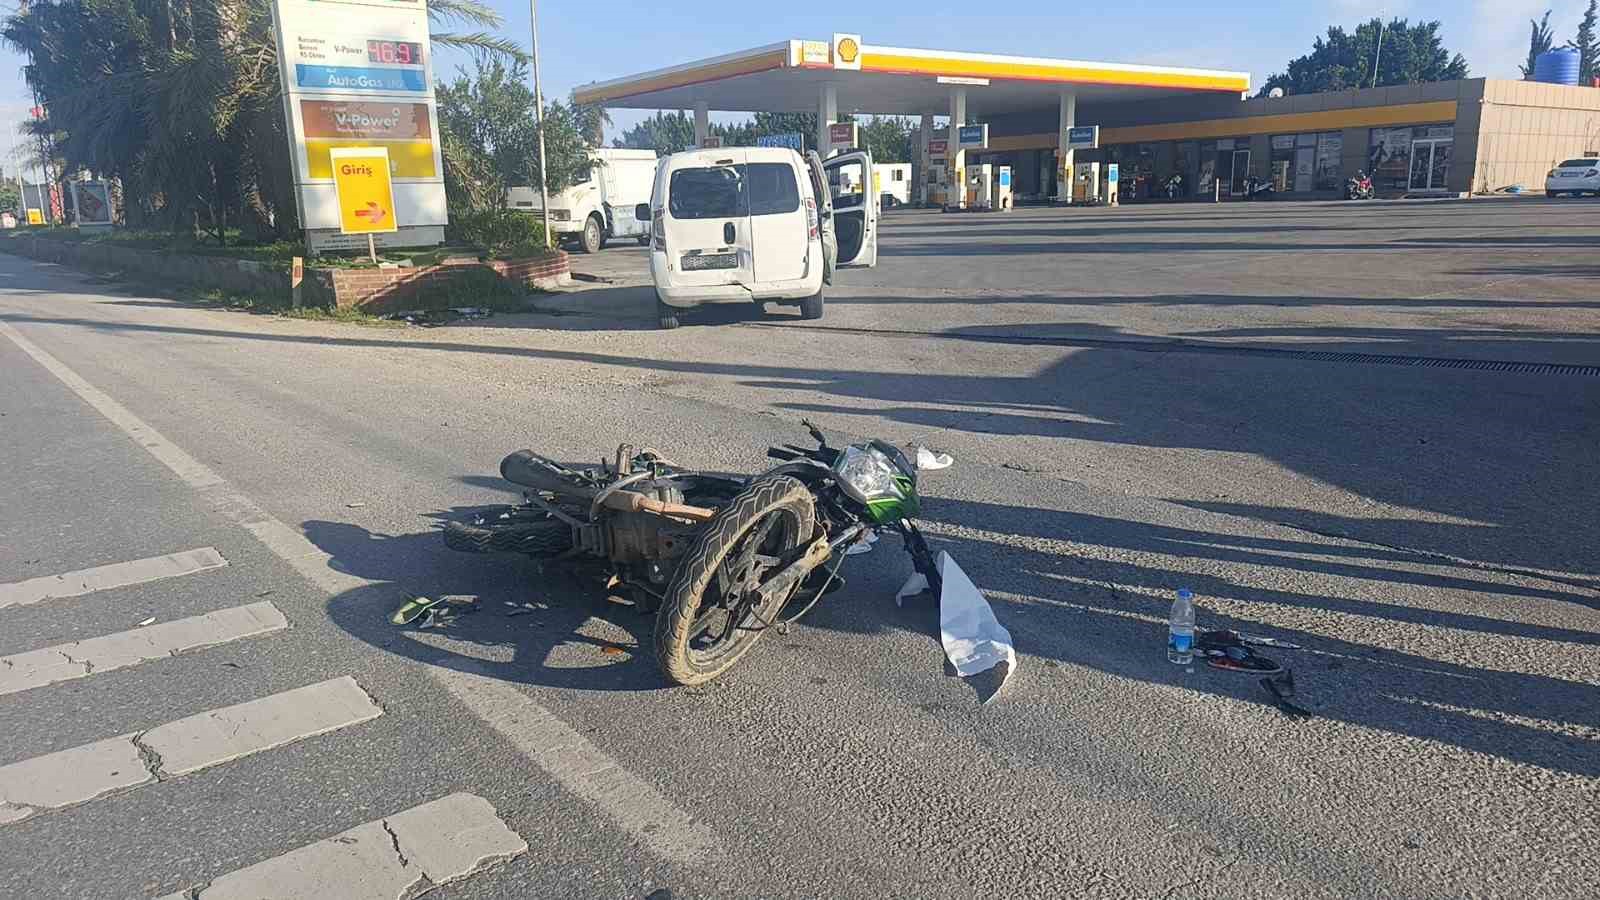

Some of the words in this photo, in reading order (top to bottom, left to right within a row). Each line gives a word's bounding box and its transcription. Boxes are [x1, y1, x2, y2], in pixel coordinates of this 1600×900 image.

[333, 44, 363, 55] V-Power
[327, 73, 383, 88] AutoGas
[335, 112, 400, 128] V-Power
[341, 163, 373, 177] Giriş
